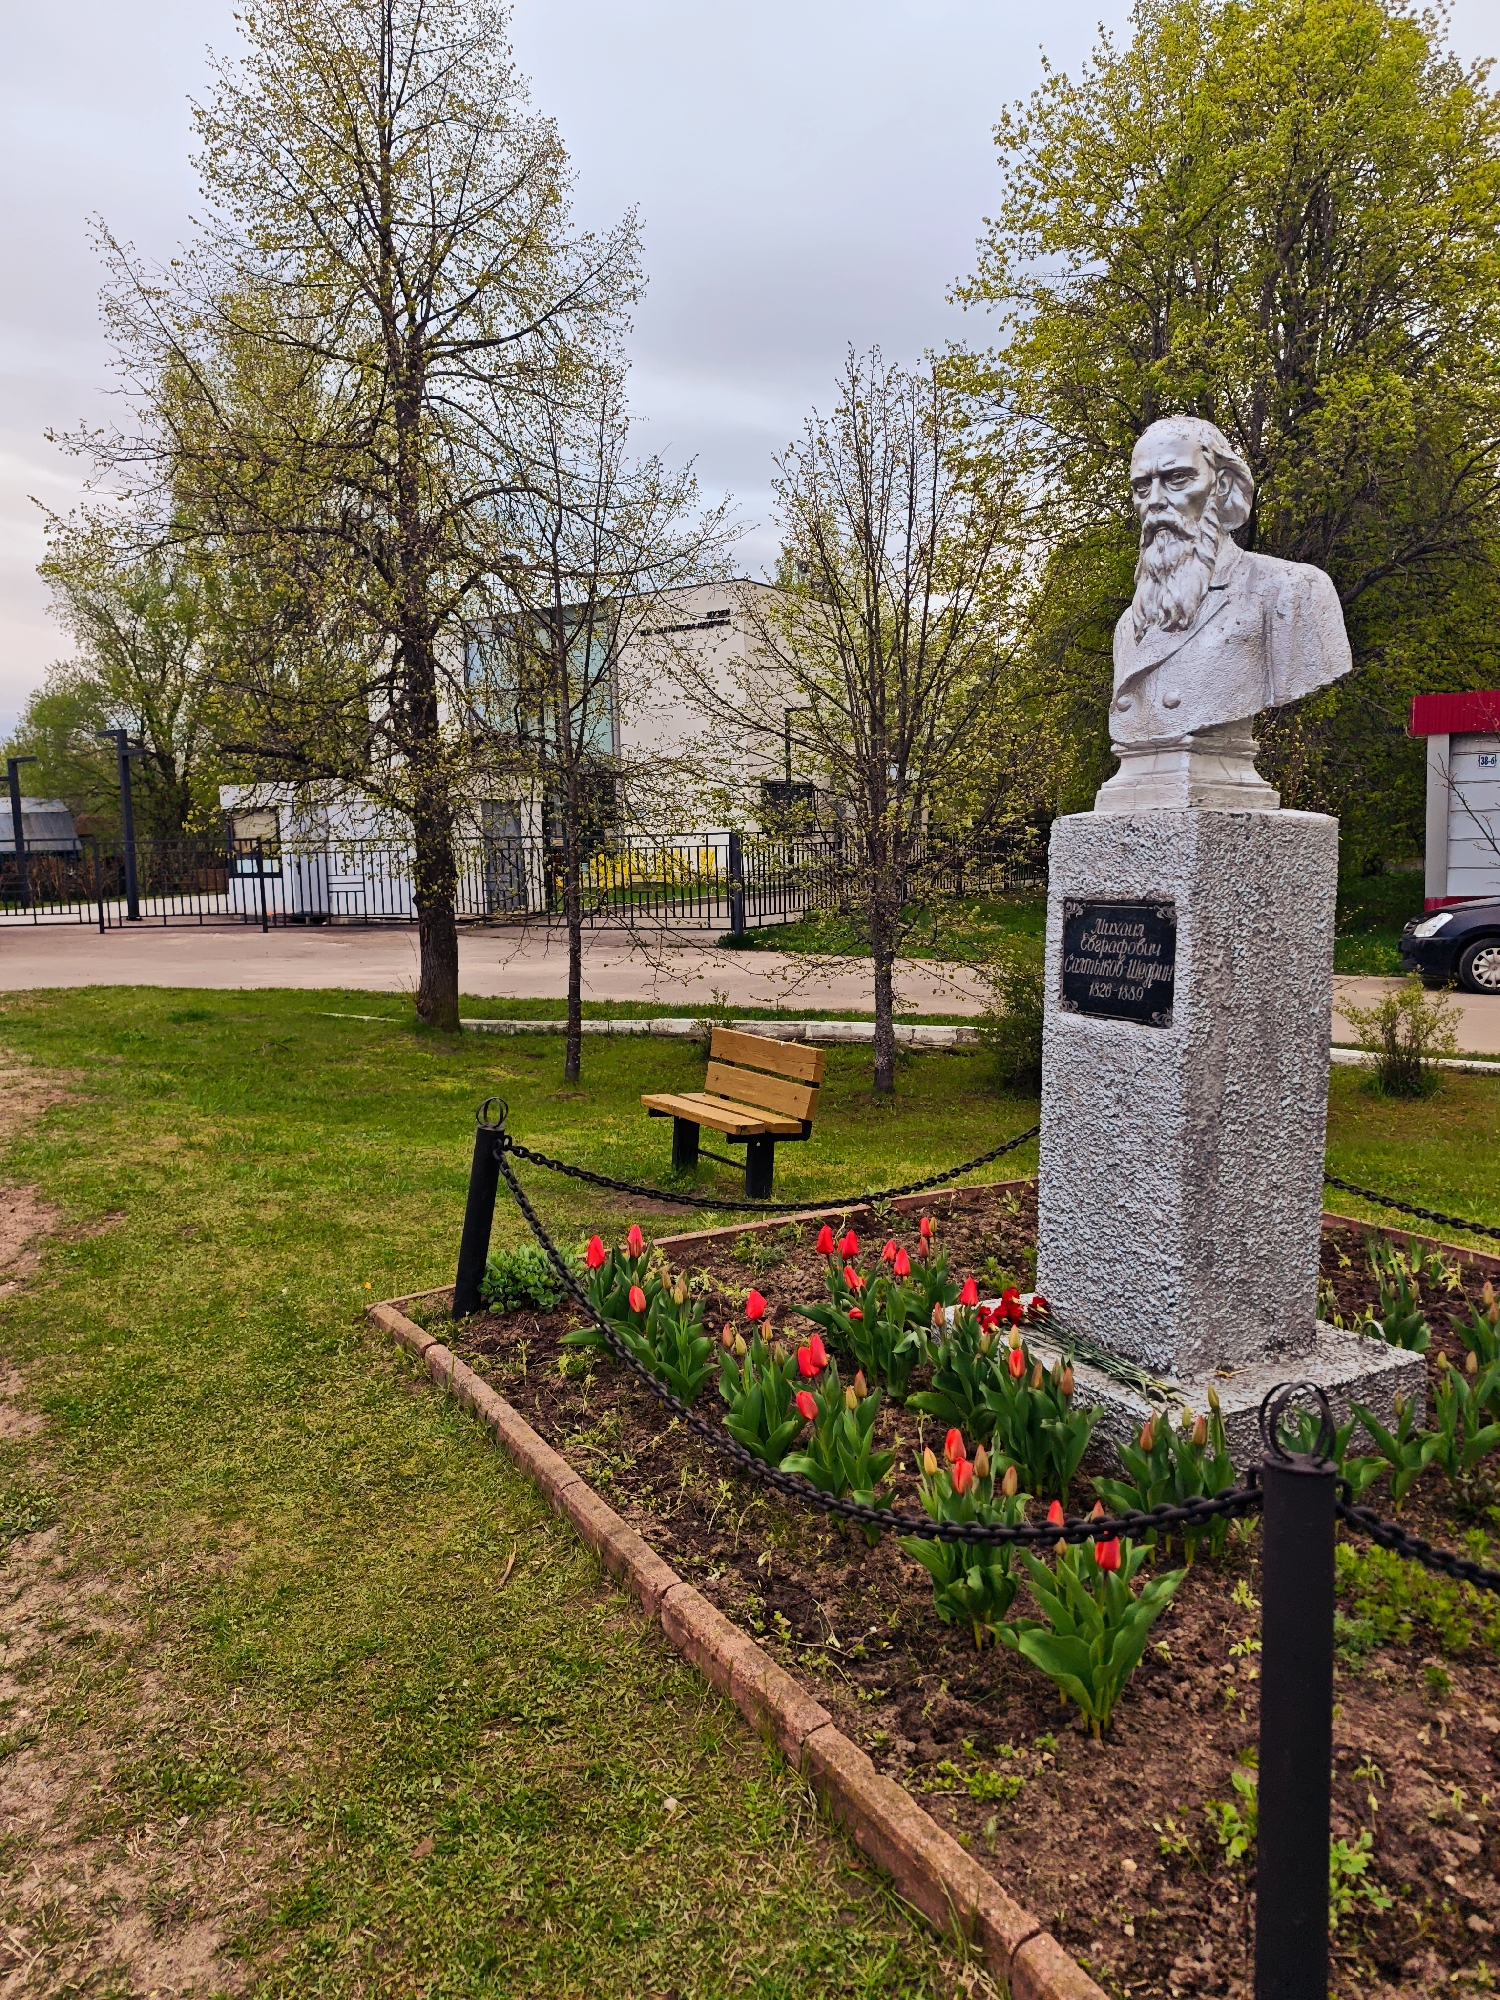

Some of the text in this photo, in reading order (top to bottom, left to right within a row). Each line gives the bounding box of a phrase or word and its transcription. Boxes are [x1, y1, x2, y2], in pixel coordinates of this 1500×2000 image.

[1091, 918, 1145, 937] Михаил
[1080, 931, 1162, 958] Евграфович
[1064, 953, 1175, 988] Салтыков-Щедрин
[1089, 981, 1145, 1001] 1826-1889
